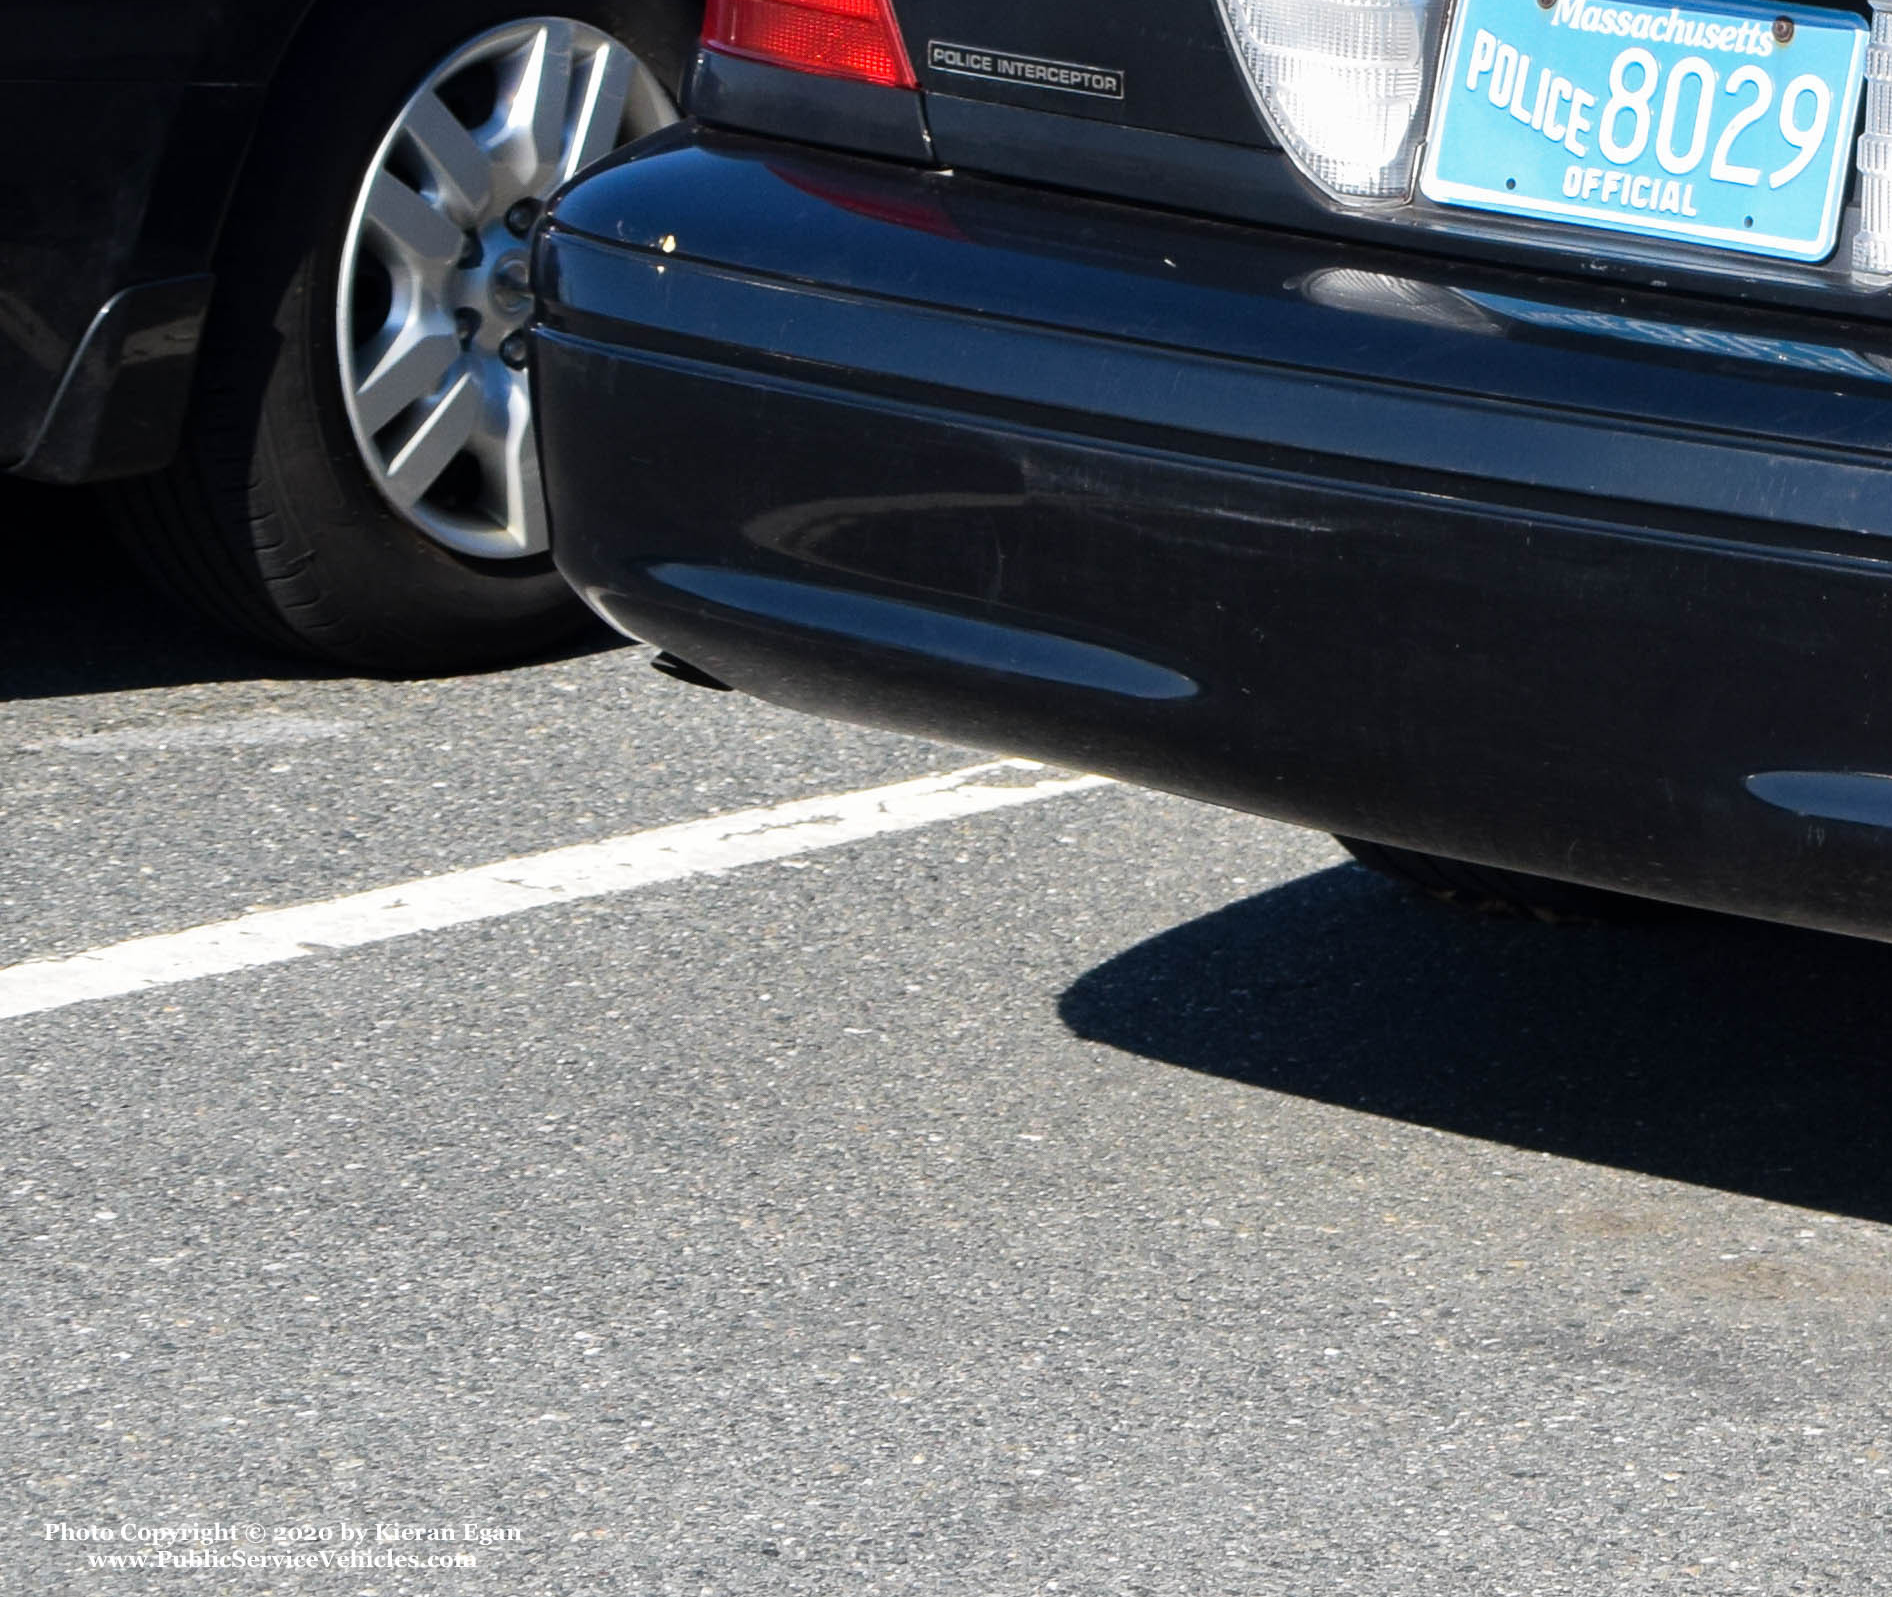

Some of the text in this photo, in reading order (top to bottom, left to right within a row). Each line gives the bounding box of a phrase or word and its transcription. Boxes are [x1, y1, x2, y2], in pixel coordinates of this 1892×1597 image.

[933, 48, 1117, 91] POLICE INTERCEPTOR
[1466, 29, 1830, 189] POLICE 8029
[1562, 165, 1698, 217] OFFICIAL
